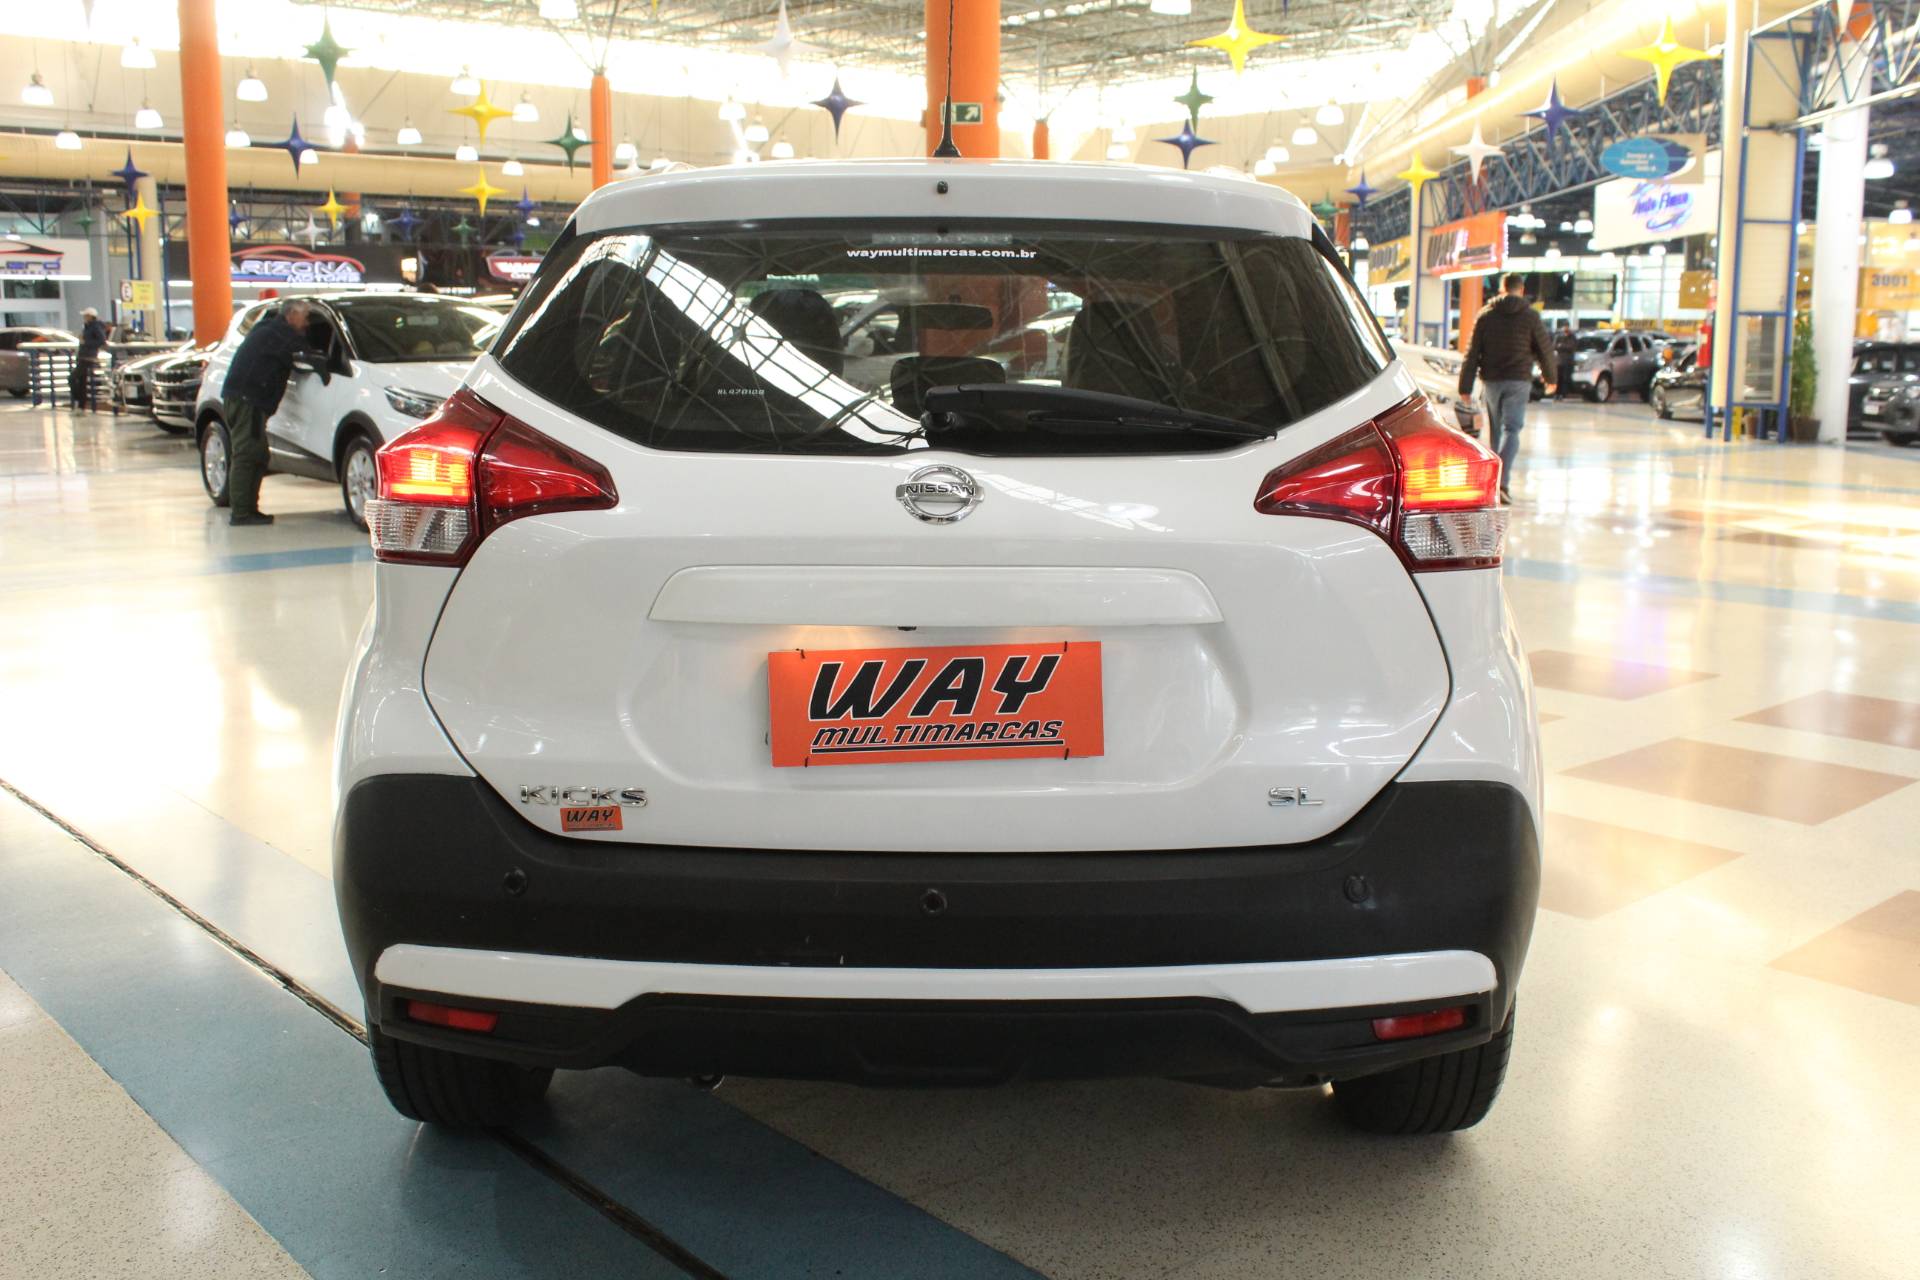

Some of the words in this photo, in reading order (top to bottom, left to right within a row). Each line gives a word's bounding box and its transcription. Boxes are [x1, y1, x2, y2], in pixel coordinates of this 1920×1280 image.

[847, 247, 1037, 259] waymultimarcas.com.br
[905, 484, 976, 496] NISSAN
[807, 654, 1064, 722] WAY
[812, 720, 1065, 746] MULTIMARCAS
[520, 784, 648, 808] KICKS
[1267, 786, 1324, 807] SL
[566, 809, 614, 823] WAY
